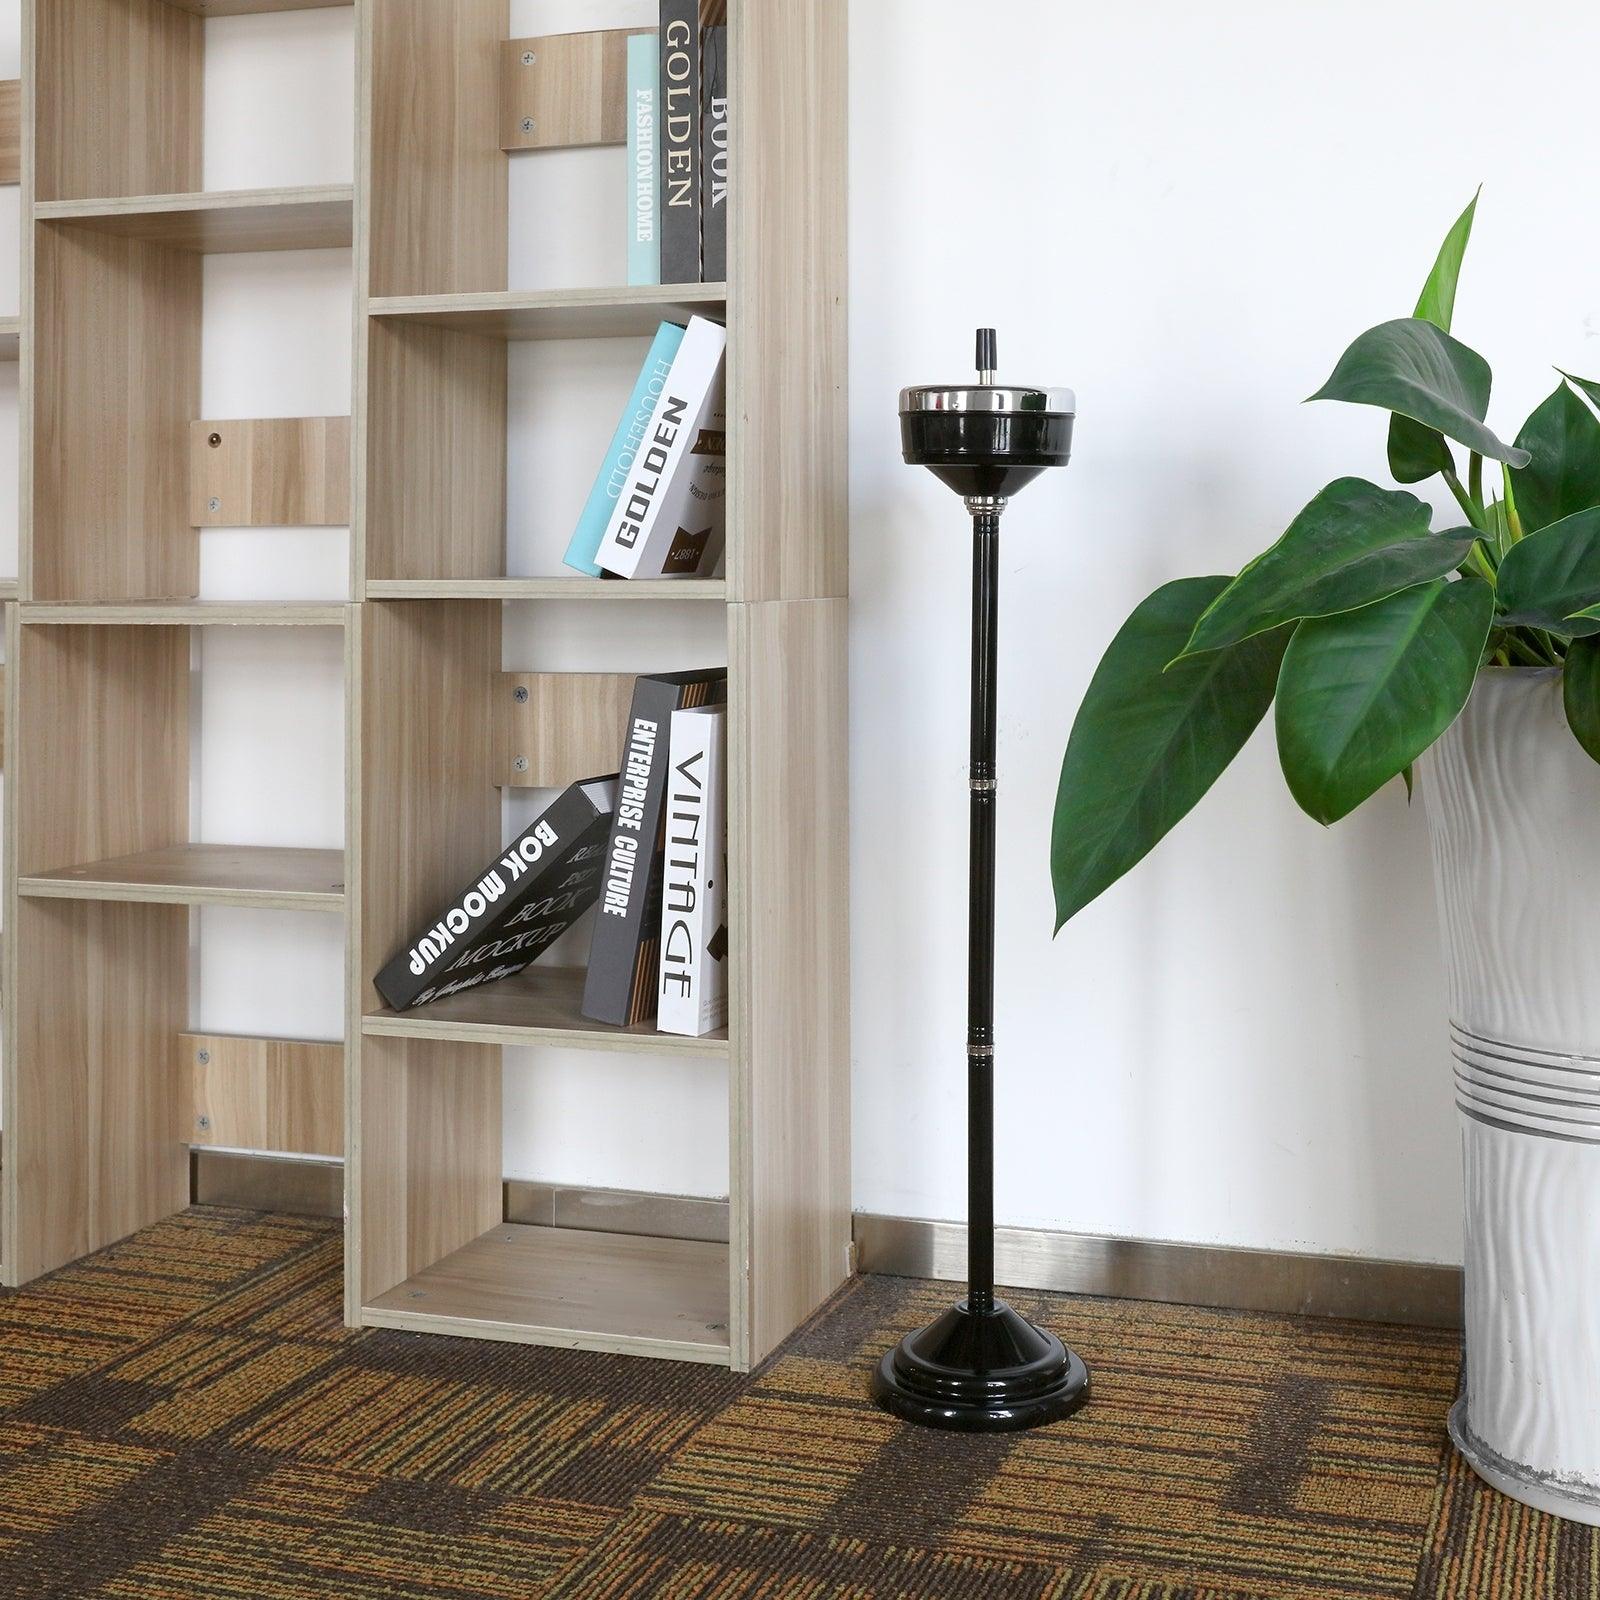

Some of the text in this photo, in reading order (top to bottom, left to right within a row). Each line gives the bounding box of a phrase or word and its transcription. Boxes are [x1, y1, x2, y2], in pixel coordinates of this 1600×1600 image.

[636, 88, 654, 242] FASHIONHOME
[666, 20, 692, 208] GOLDEN
[711, 95, 727, 208] BOOK
[606, 359, 672, 499] HOUSEHOLD
[615, 395, 688, 549] GOLDEN
[500, 819, 560, 882] BOK
[603, 718, 658, 918] ENTERPRISE CULTURE
[663, 750, 704, 999] VINTAGE
[409, 871, 508, 976] MOCKUP
[444, 921, 568, 973] MOCKUP
